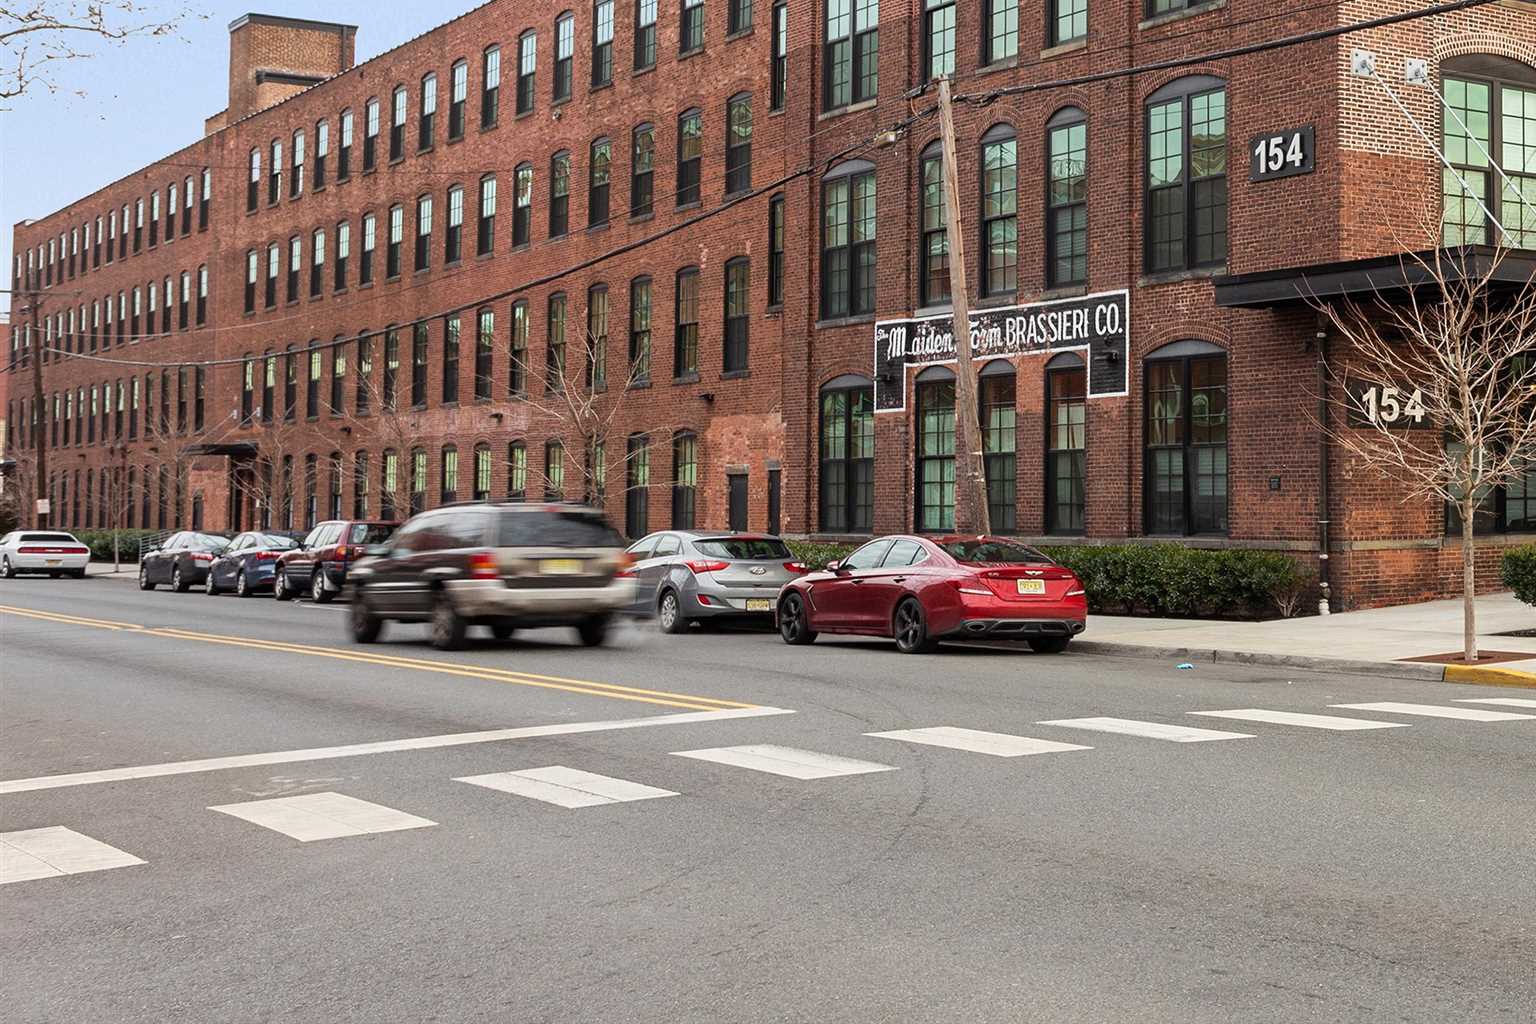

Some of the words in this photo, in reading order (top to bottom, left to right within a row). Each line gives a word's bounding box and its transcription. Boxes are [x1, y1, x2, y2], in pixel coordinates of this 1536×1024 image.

[1254, 132, 1303, 174] 154
[1094, 302, 1124, 336] CO.
[1362, 386, 1425, 424] 154
